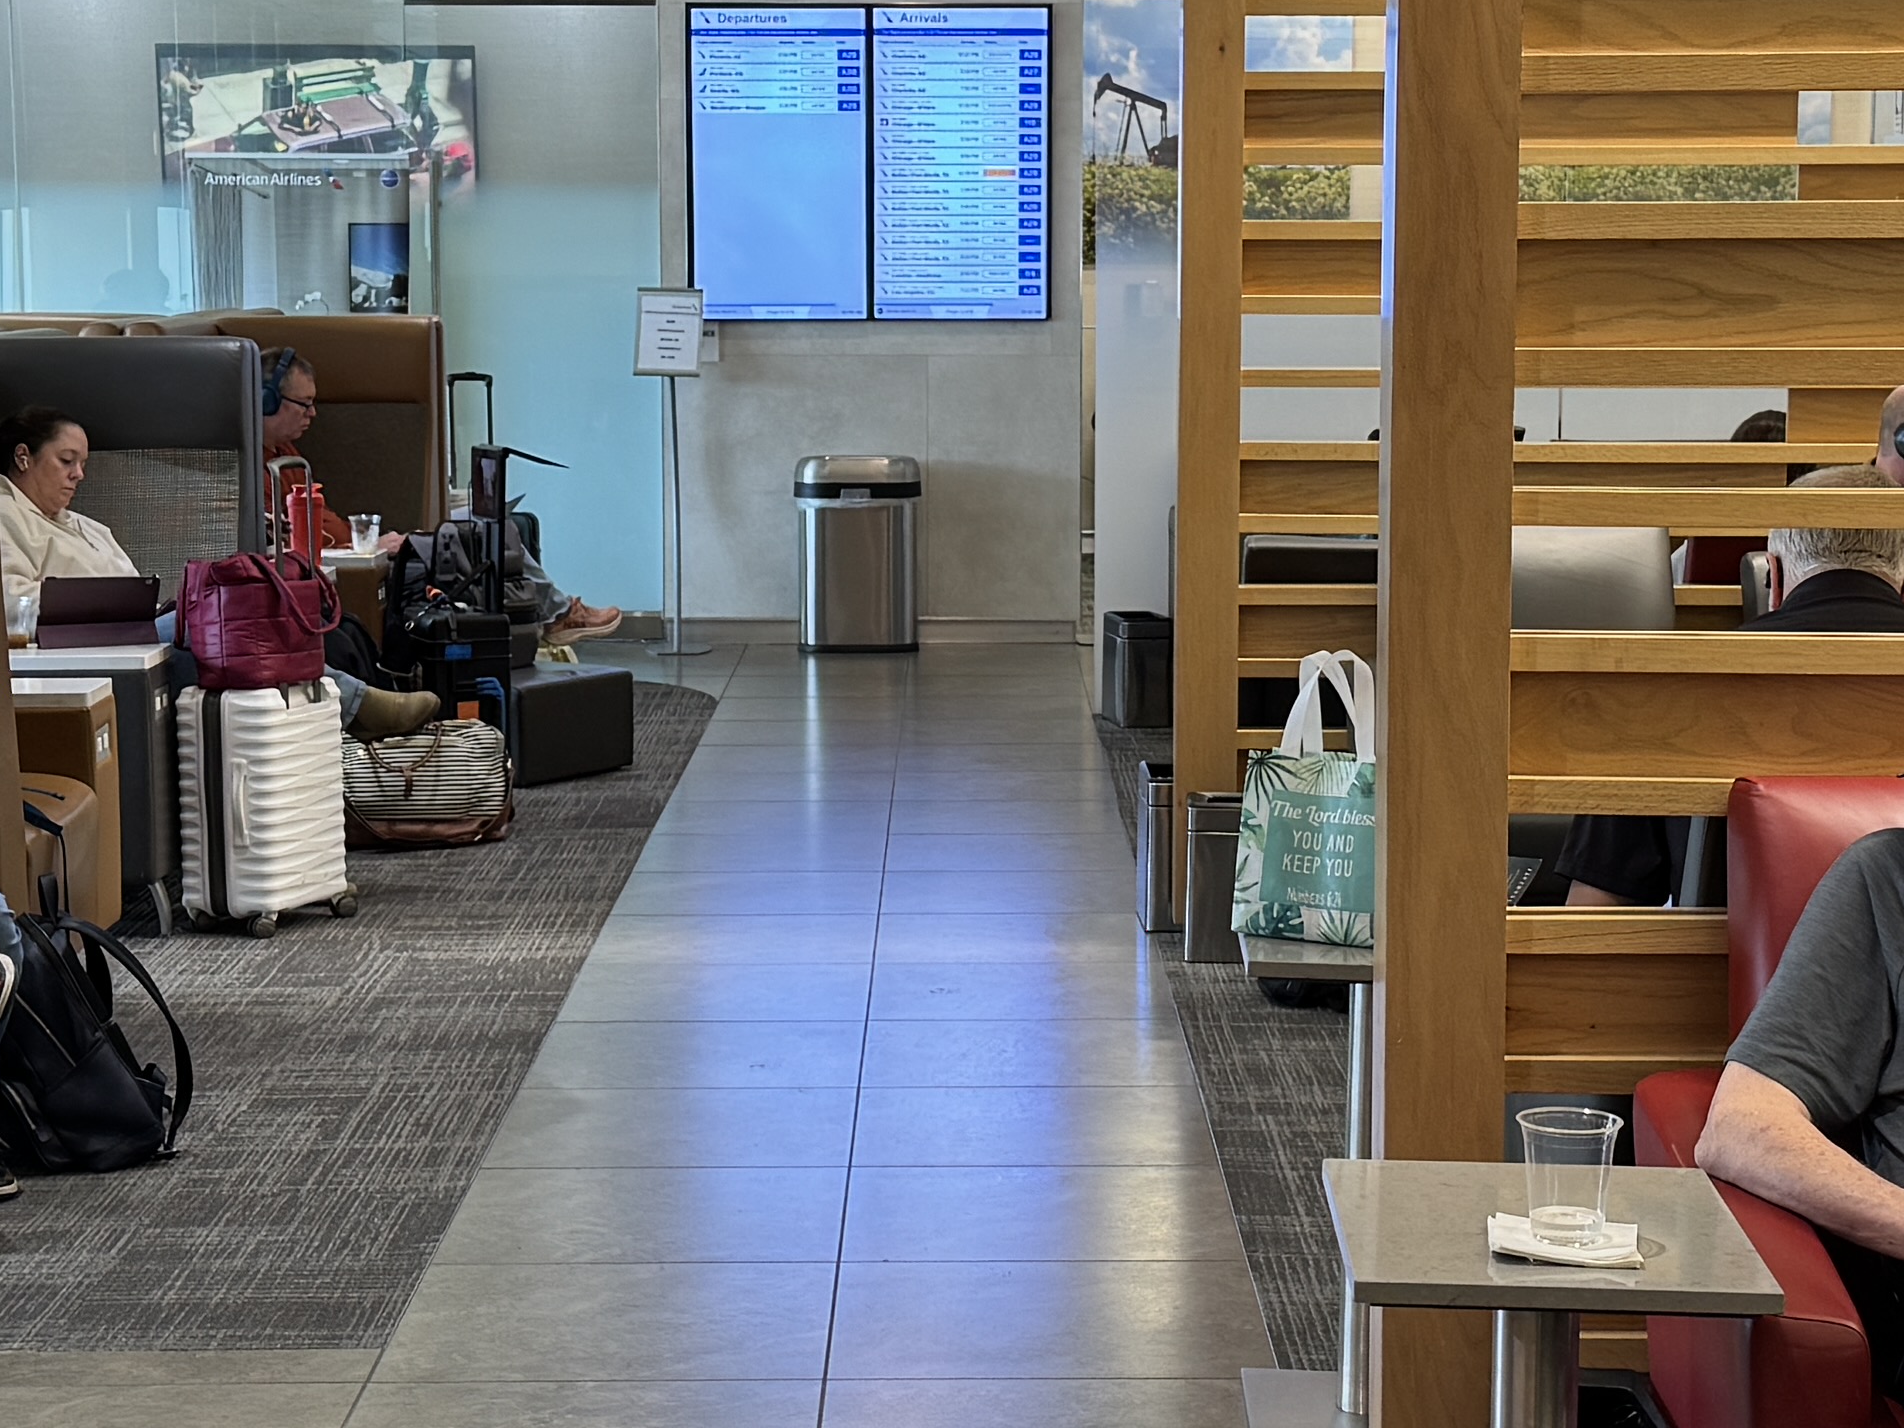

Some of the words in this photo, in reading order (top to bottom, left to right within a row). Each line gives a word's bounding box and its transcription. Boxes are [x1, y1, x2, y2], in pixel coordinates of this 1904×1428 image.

[717, 12, 787, 25] Departures
[900, 12, 948, 23] Arrivals
[204, 172, 269, 186] American
[270, 172, 322, 186] Airlines
[1271, 800, 1302, 819] The
[1306, 805, 1341, 827] Lord
[1293, 830, 1322, 851] YOU
[1326, 834, 1354, 853] AND
[1282, 853, 1321, 874] KEEP
[1326, 859, 1353, 877] YOU
